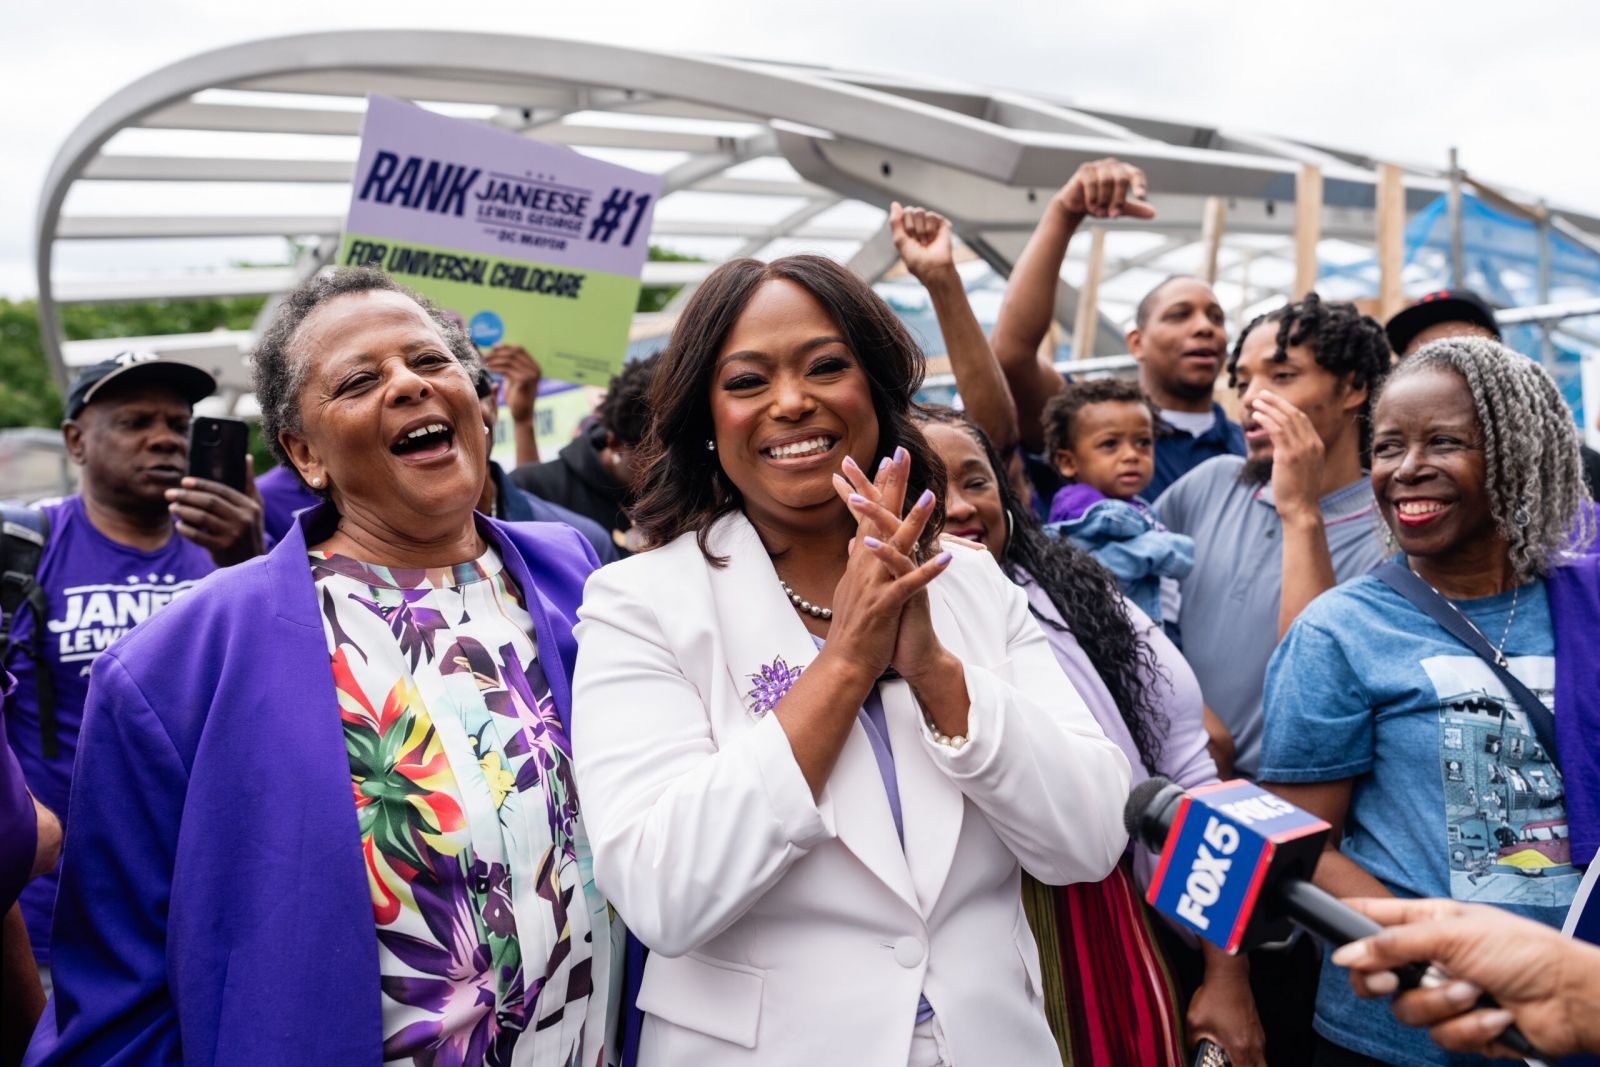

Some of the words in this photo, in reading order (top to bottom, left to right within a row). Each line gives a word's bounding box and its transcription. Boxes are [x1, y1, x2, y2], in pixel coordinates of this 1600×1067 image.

[359, 150, 482, 218] RANK
[476, 179, 590, 218] JANEESE
[588, 187, 651, 246] #1
[477, 203, 524, 223] LEWIS
[527, 212, 584, 233] GEORGE
[498, 229, 518, 242] DC
[520, 234, 569, 250] MAYOR
[346, 240, 388, 268] FOR
[387, 246, 489, 285] UNIVERSAL
[488, 262, 587, 299] CHILDCARE
[47, 591, 190, 633] JANE
[1203, 815, 1241, 855] 5
[1175, 842, 1233, 931] FOX
